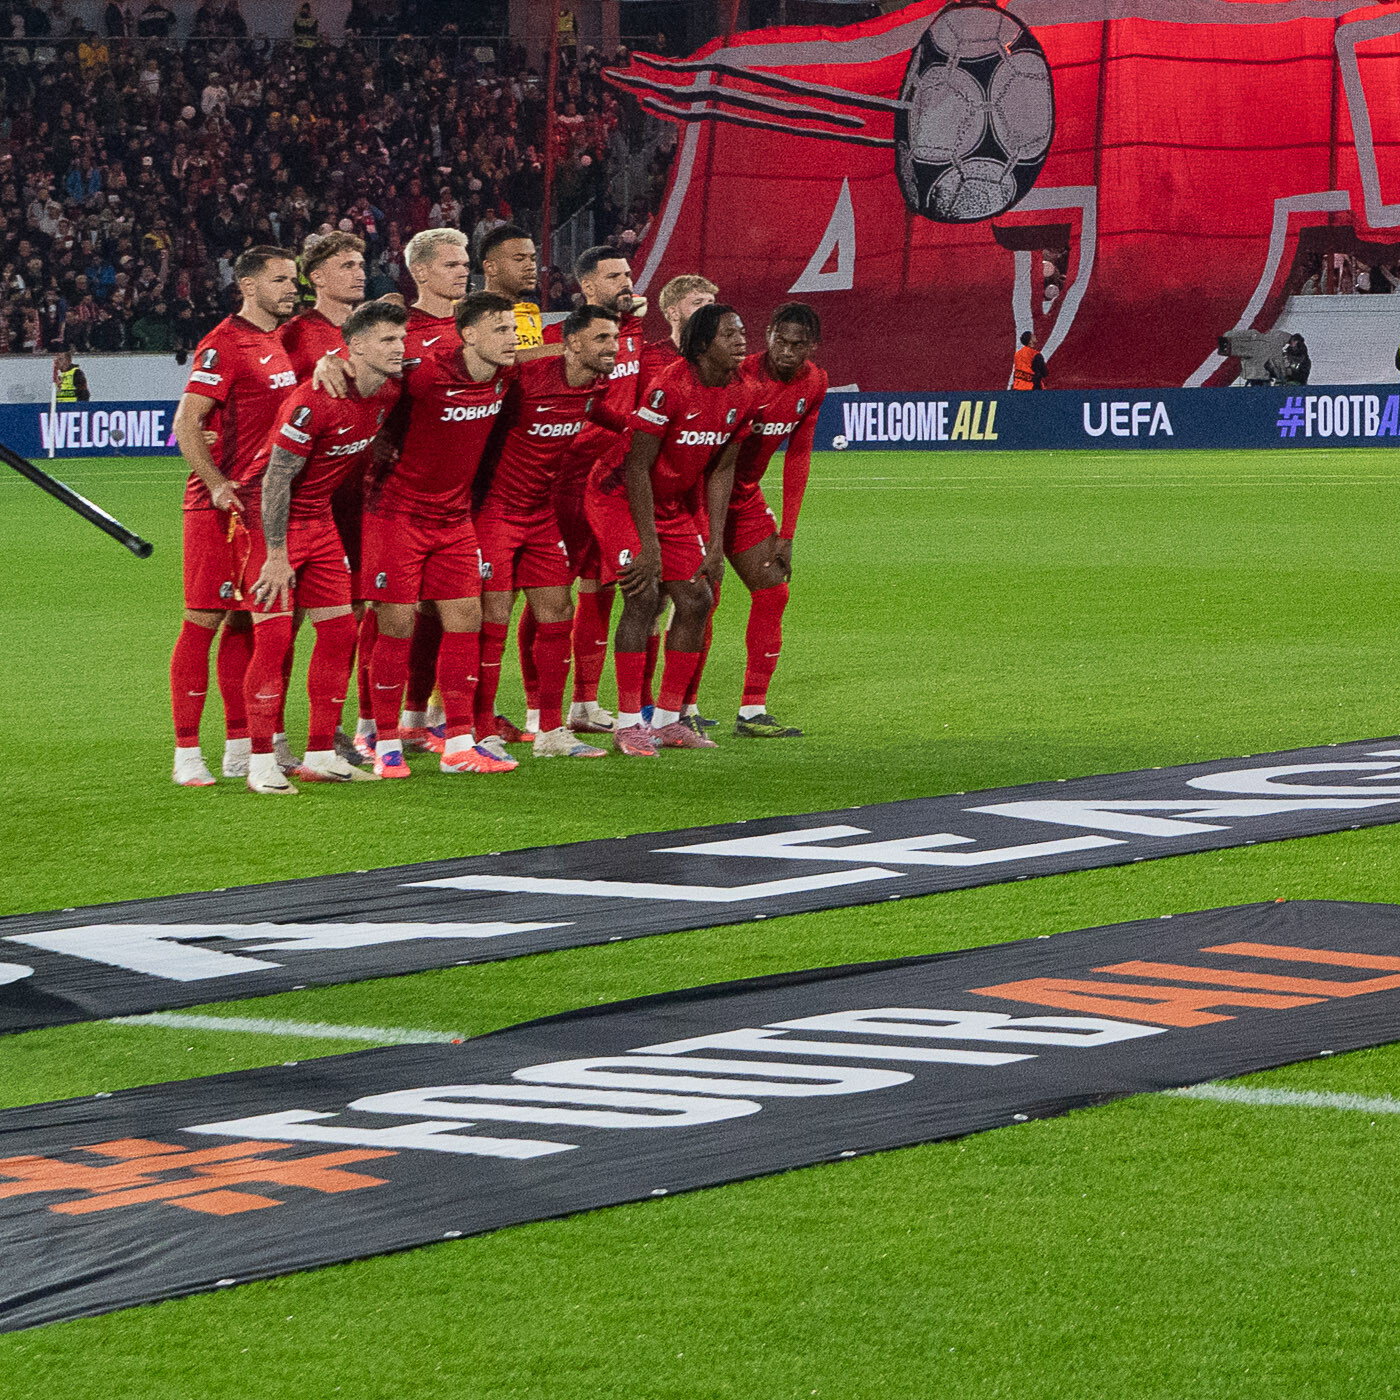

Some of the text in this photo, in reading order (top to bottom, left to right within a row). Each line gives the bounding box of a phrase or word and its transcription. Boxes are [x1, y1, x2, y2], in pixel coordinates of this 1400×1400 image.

[39, 410, 165, 449] WELCOME
[842, 400, 998, 442] WELCOME ALL
[1083, 401, 1174, 437] UEFA
